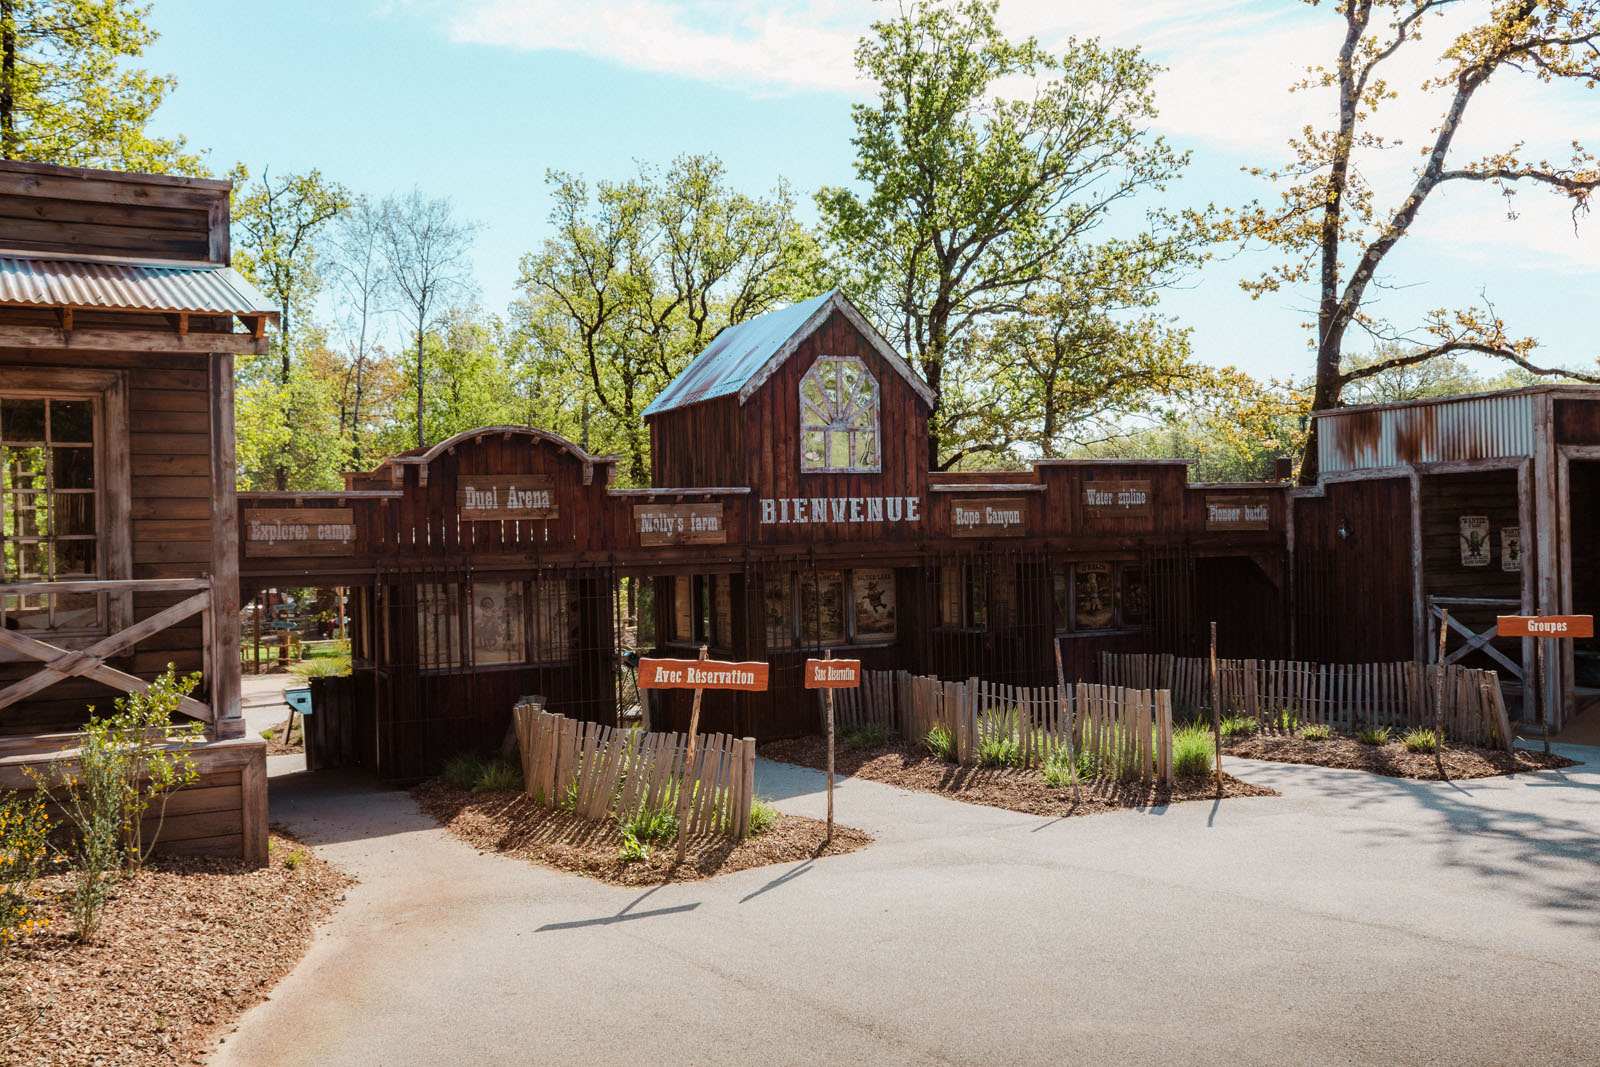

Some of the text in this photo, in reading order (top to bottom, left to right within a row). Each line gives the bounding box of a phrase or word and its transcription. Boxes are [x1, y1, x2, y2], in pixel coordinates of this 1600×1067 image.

[465, 486, 550, 509] Duel Arena
[1087, 488, 1146, 509] Water zipline
[759, 497, 921, 524] BIENVENUE
[956, 506, 1020, 528] Rope Canyon
[1209, 504, 1267, 521] Pioneer battle
[251, 520, 351, 545] Explorer camp
[641, 512, 718, 536] Molly's farm
[1527, 620, 1568, 633] Groupes
[654, 666, 755, 684] Avec Réservation
